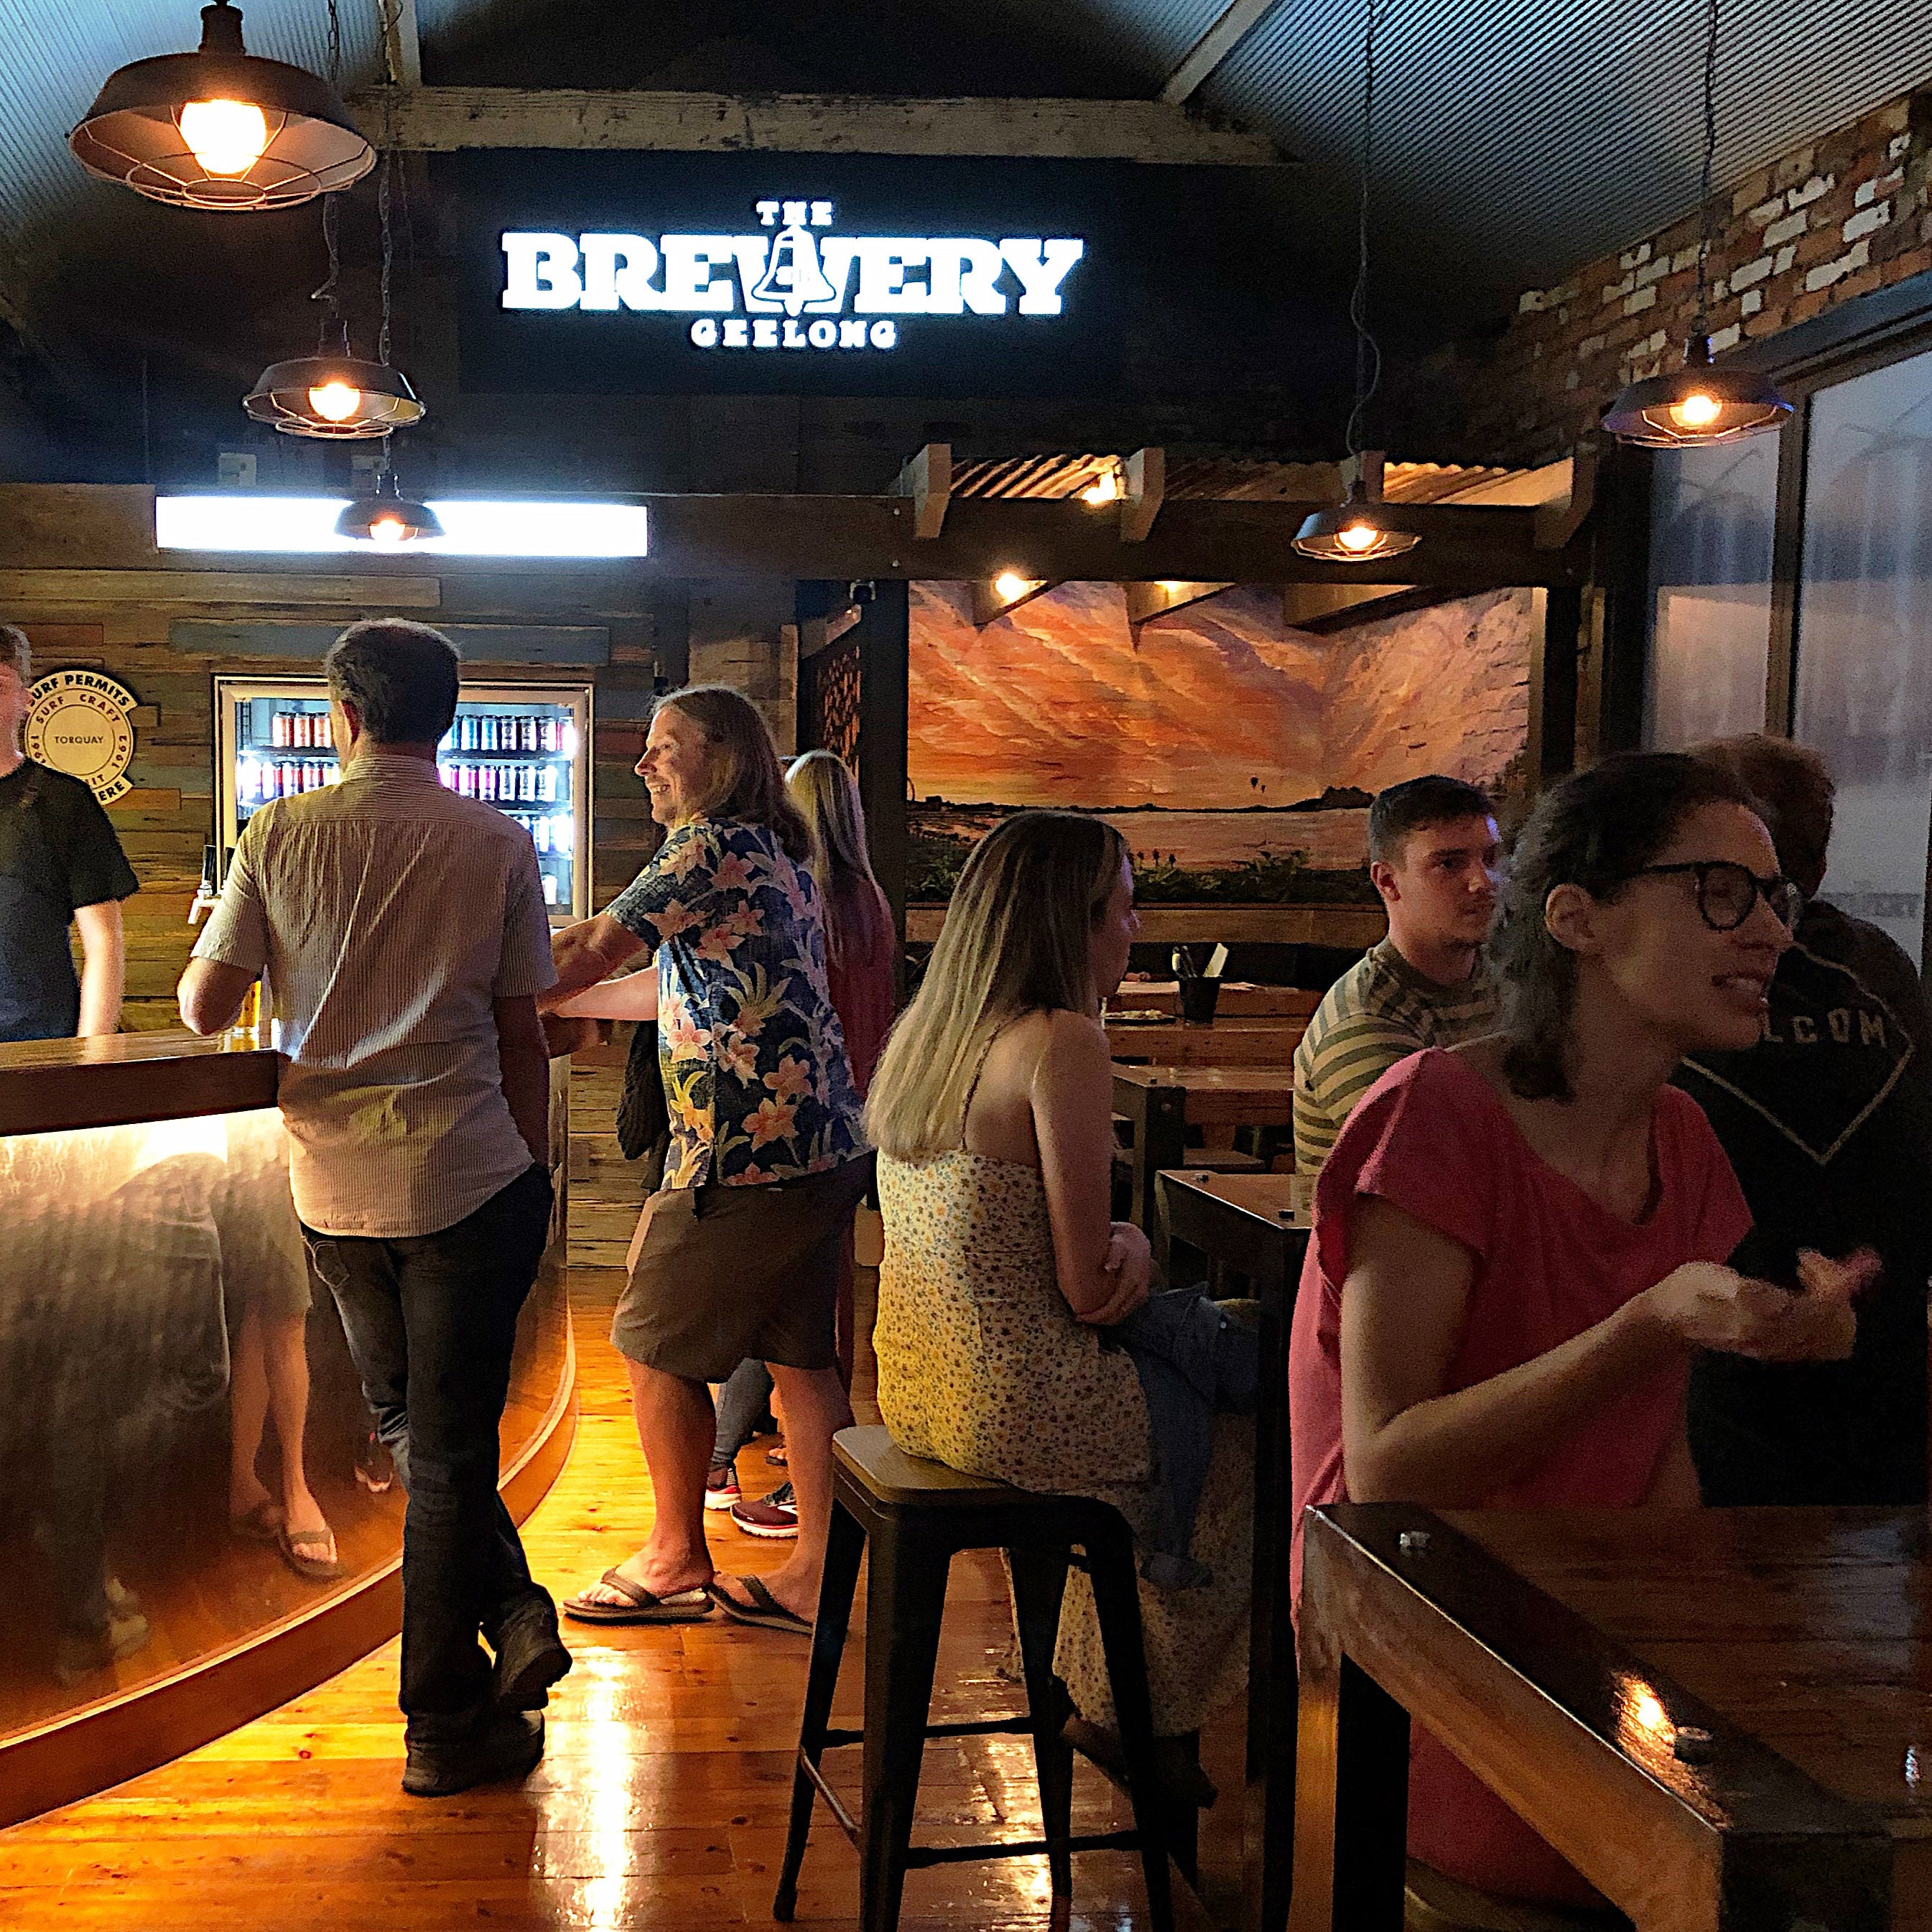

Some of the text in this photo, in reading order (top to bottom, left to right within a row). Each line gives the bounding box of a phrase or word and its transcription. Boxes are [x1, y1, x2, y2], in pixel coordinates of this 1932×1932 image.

[756, 200, 832, 226] THE
[501, 231, 1084, 315] BREWERY
[690, 318, 898, 349] GEELONG
[65, 674, 129, 706] PERMITS
[36, 694, 121, 724] SURF CRAFT
[54, 735, 103, 744] TORQUAY
[111, 735, 127, 768] 1962
[98, 781, 124, 802] ERE
[1759, 1008, 1887, 1049] LCOM
